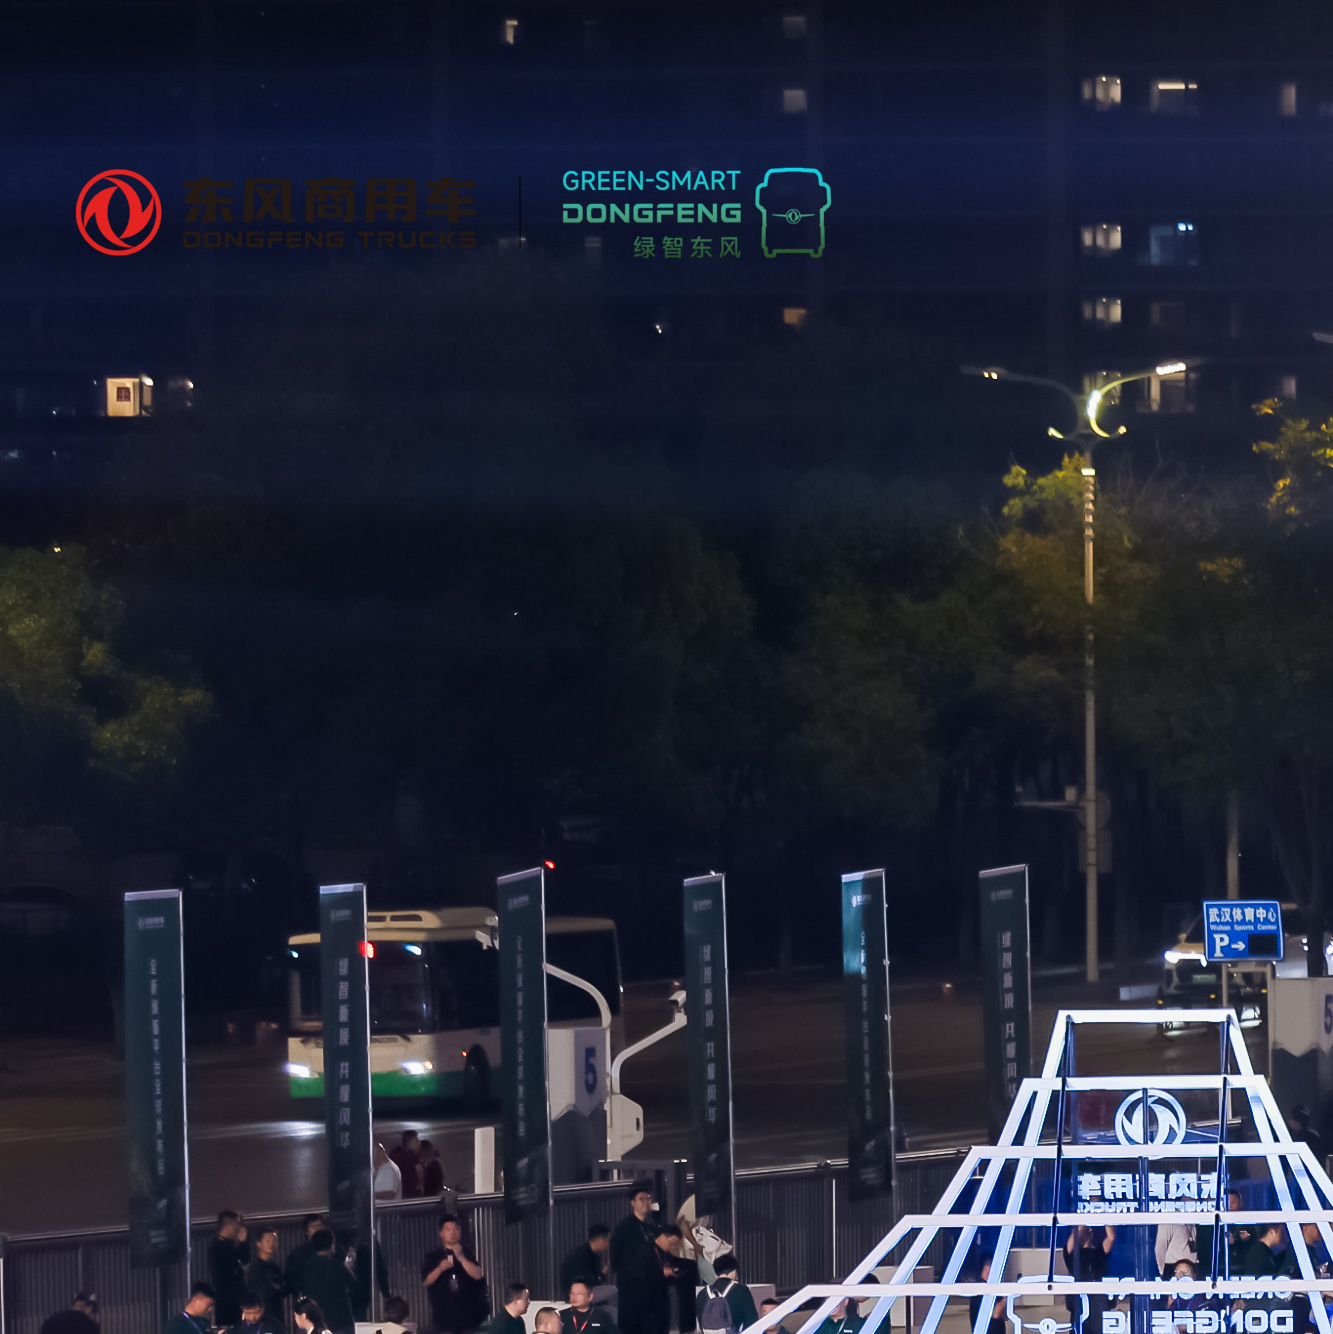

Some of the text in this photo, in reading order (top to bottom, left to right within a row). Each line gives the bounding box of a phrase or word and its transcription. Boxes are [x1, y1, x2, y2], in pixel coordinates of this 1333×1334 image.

[1209, 907, 1277, 922] 武汉体育中心
[1324, 994, 1333, 1034] 5
[584, 1047, 597, 1094] 5
